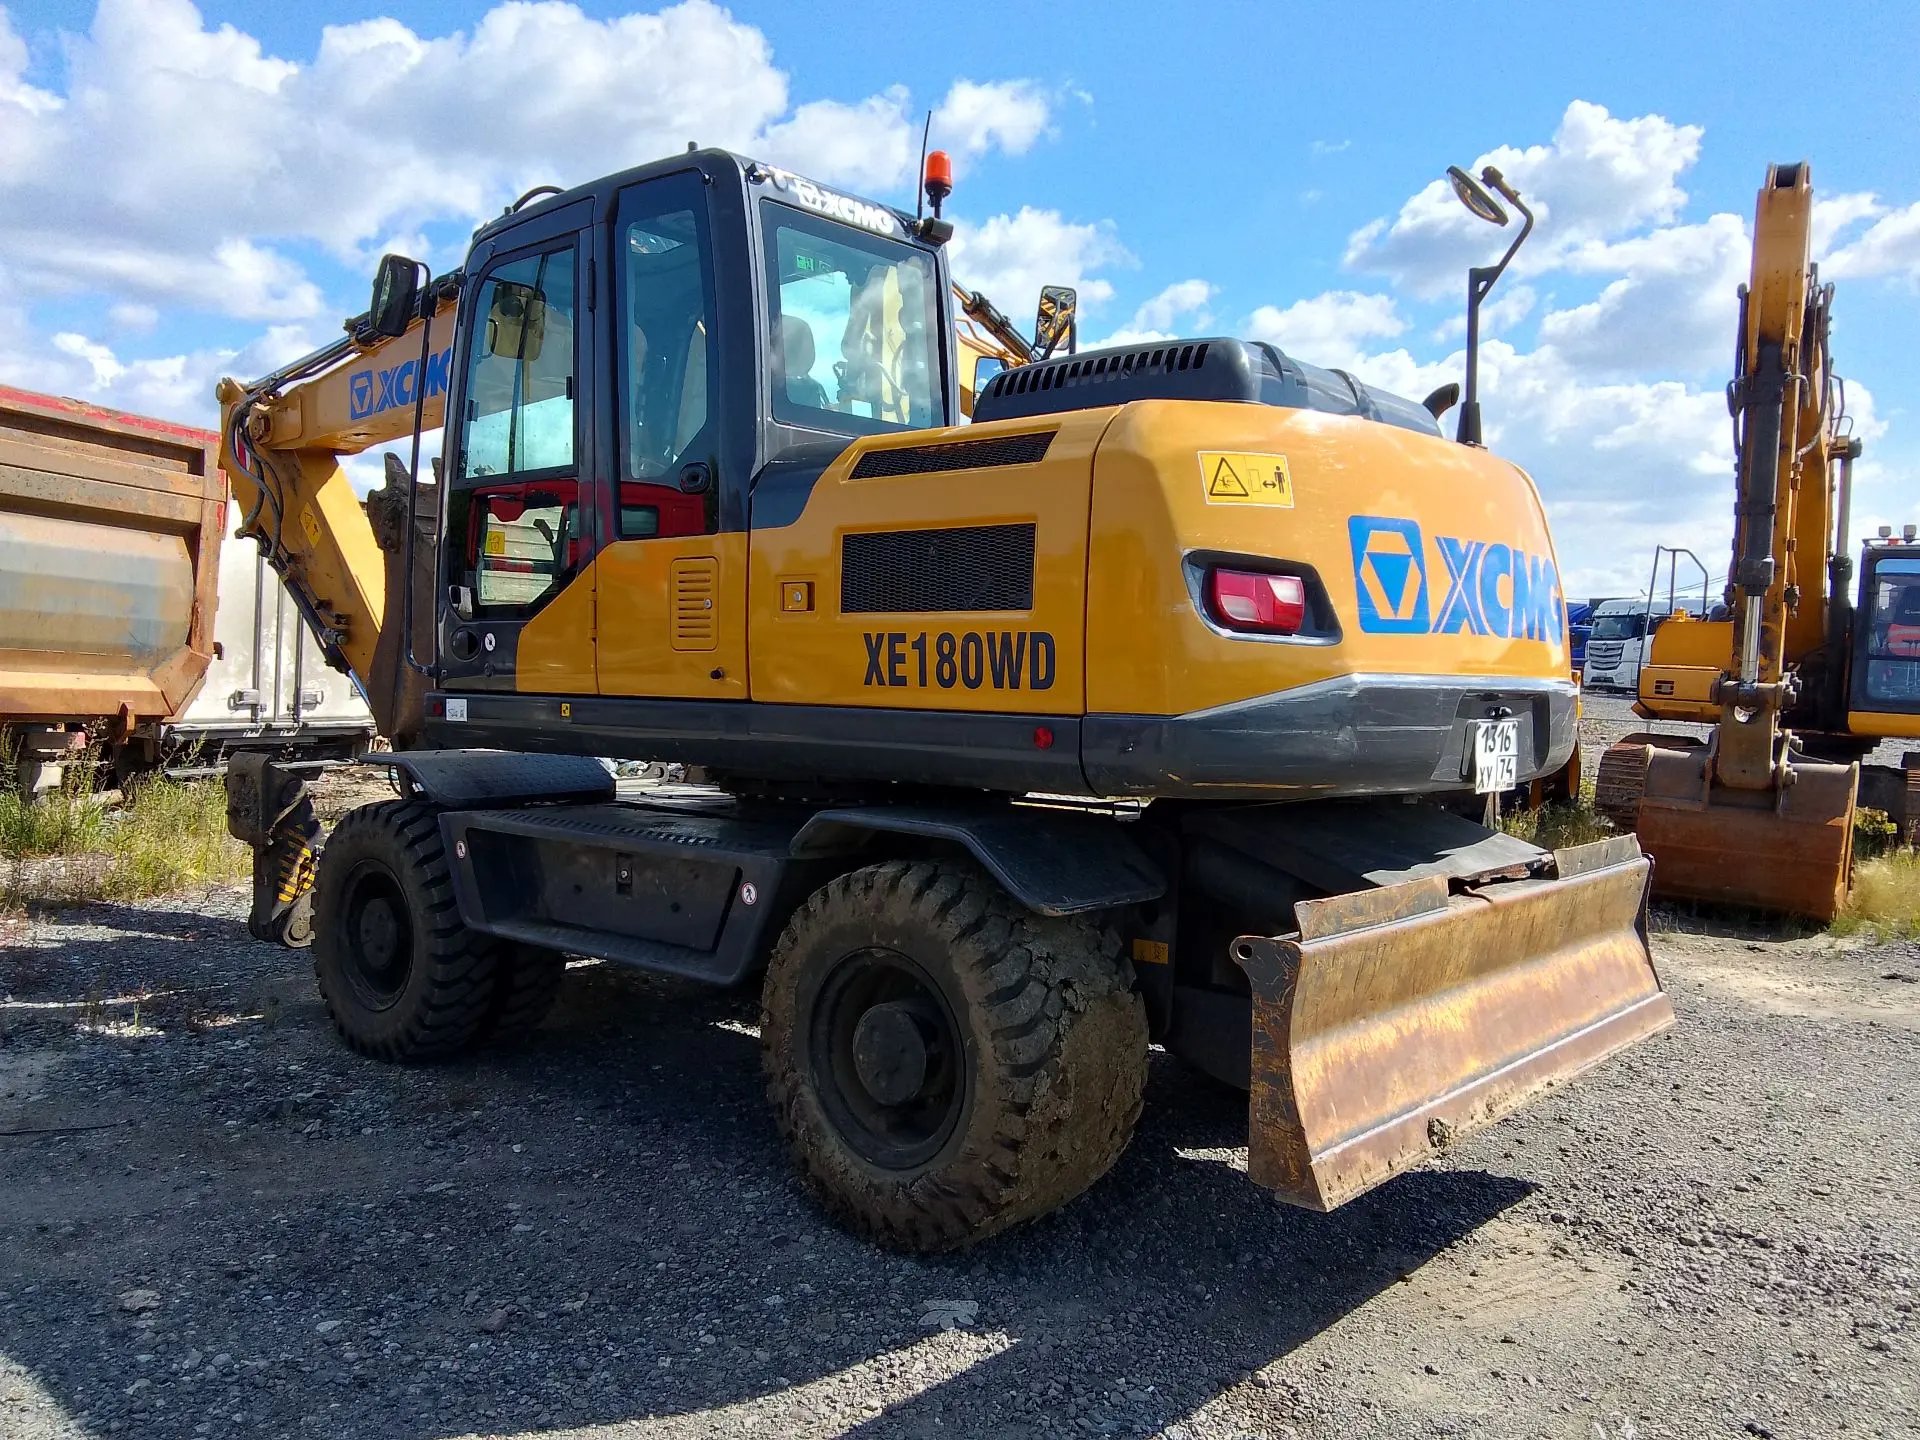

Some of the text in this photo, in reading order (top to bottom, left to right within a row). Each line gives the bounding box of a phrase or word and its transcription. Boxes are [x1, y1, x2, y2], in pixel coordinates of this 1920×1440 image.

[820, 189, 894, 234] XCMG
[1432, 535, 1563, 646] XCMG
[863, 632, 1056, 690] XE180WD
[1481, 724, 1512, 753] 1316
[1500, 758, 1513, 779] 74
